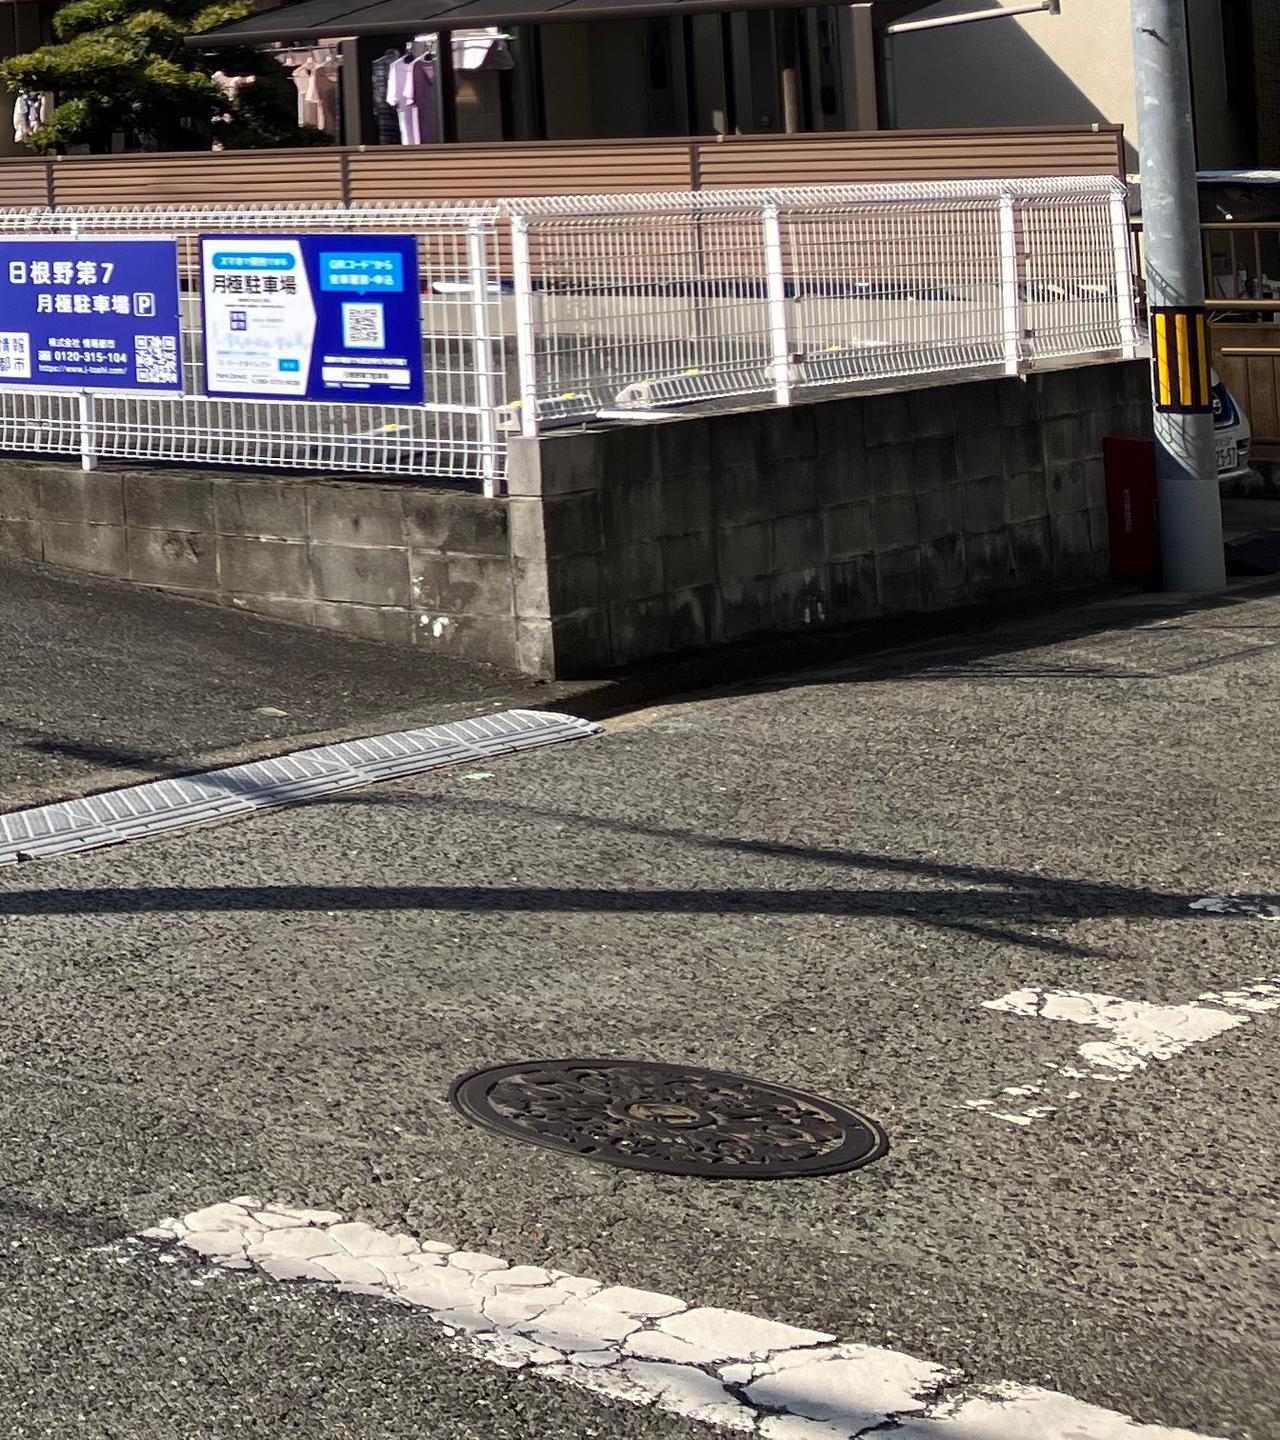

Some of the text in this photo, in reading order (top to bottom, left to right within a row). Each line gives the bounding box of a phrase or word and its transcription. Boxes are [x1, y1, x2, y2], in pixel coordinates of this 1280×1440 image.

[8, 260, 115, 285] 日根野第7
[212, 274, 297, 295] 月極駐車場
[36, 293, 131, 315] 月極駐車場
[54, 350, 128, 364] 0120-315-104
